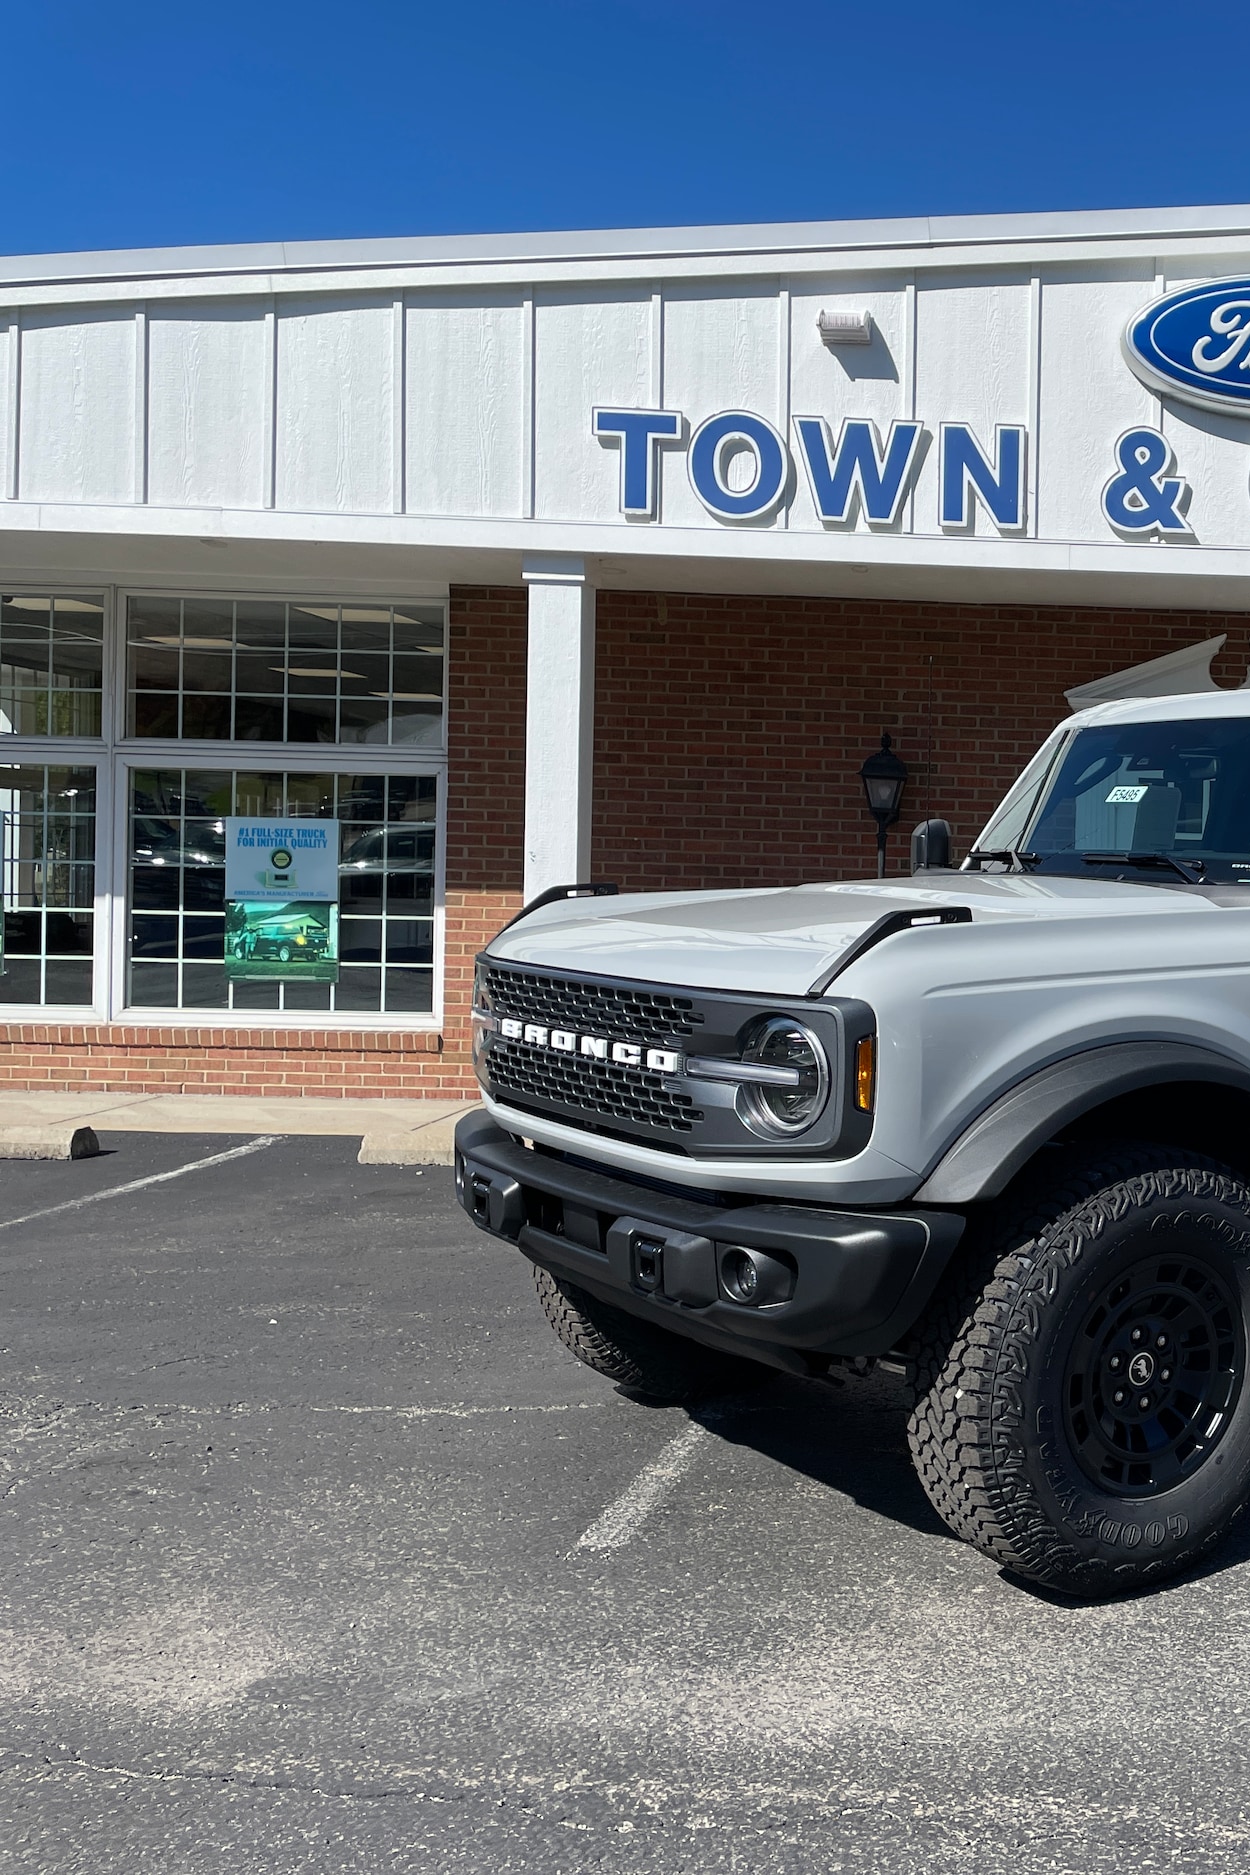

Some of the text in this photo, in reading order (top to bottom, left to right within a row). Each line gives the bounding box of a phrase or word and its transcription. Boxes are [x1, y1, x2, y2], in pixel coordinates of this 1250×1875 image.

[591, 406, 1026, 531] TOWN
[1101, 426, 1193, 535] &
[1110, 789, 1141, 801] F5495
[239, 827, 326, 838] #1 FULL-SIZE TRUCK
[237, 838, 328, 849] FOR INITIAL QUALITY
[501, 1017, 680, 1073] BRONCO
